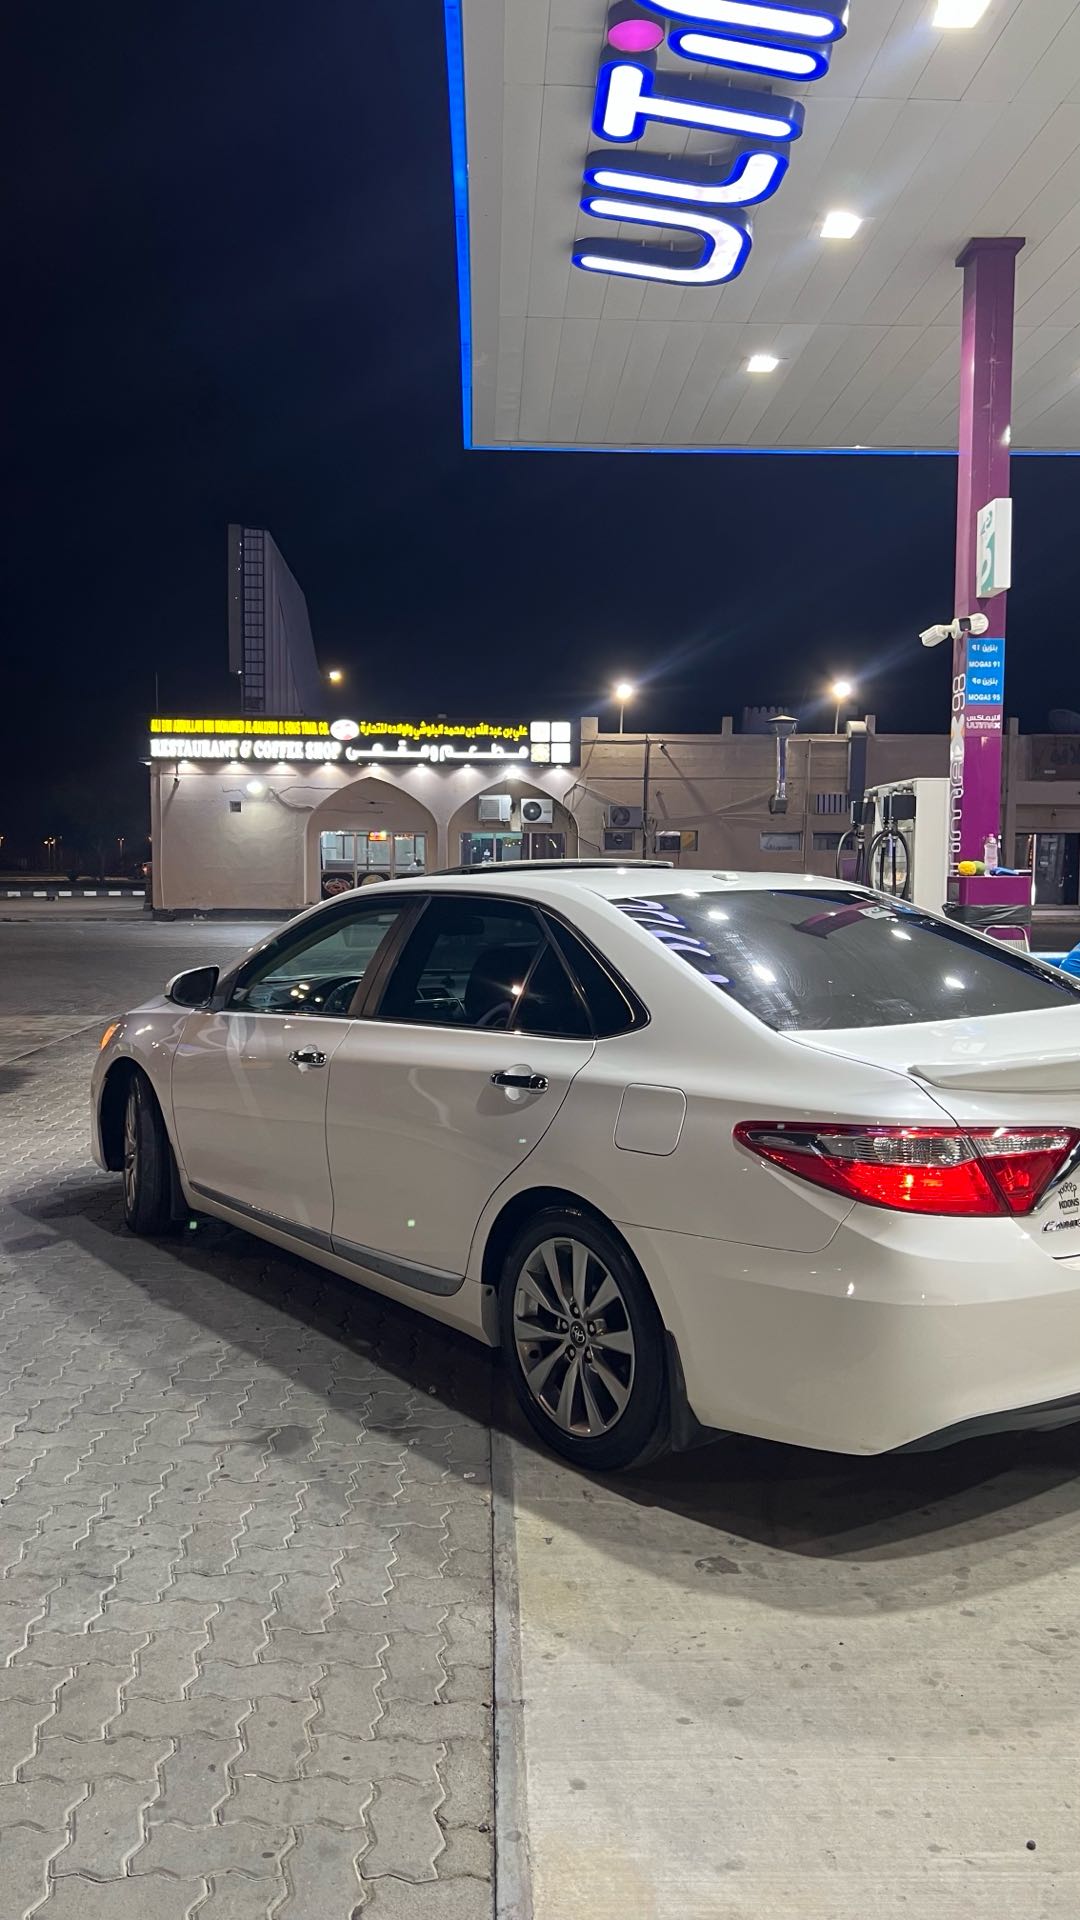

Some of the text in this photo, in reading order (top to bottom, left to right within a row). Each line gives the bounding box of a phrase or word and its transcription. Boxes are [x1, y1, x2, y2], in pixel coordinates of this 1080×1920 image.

[968, 693, 1001, 701] MOGAS 95
[413, 721, 444, 740] البلوشي
[444, 725, 465, 737] محمد
[465, 726, 476, 739] بن
[502, 726, 513, 739] بن
[513, 724, 528, 741] علي
[150, 739, 342, 760] RESTAURANT & COFFEE SHOP
[439, 743, 529, 762] مطعم
[1058, 1198, 1080, 1209] KOONS
